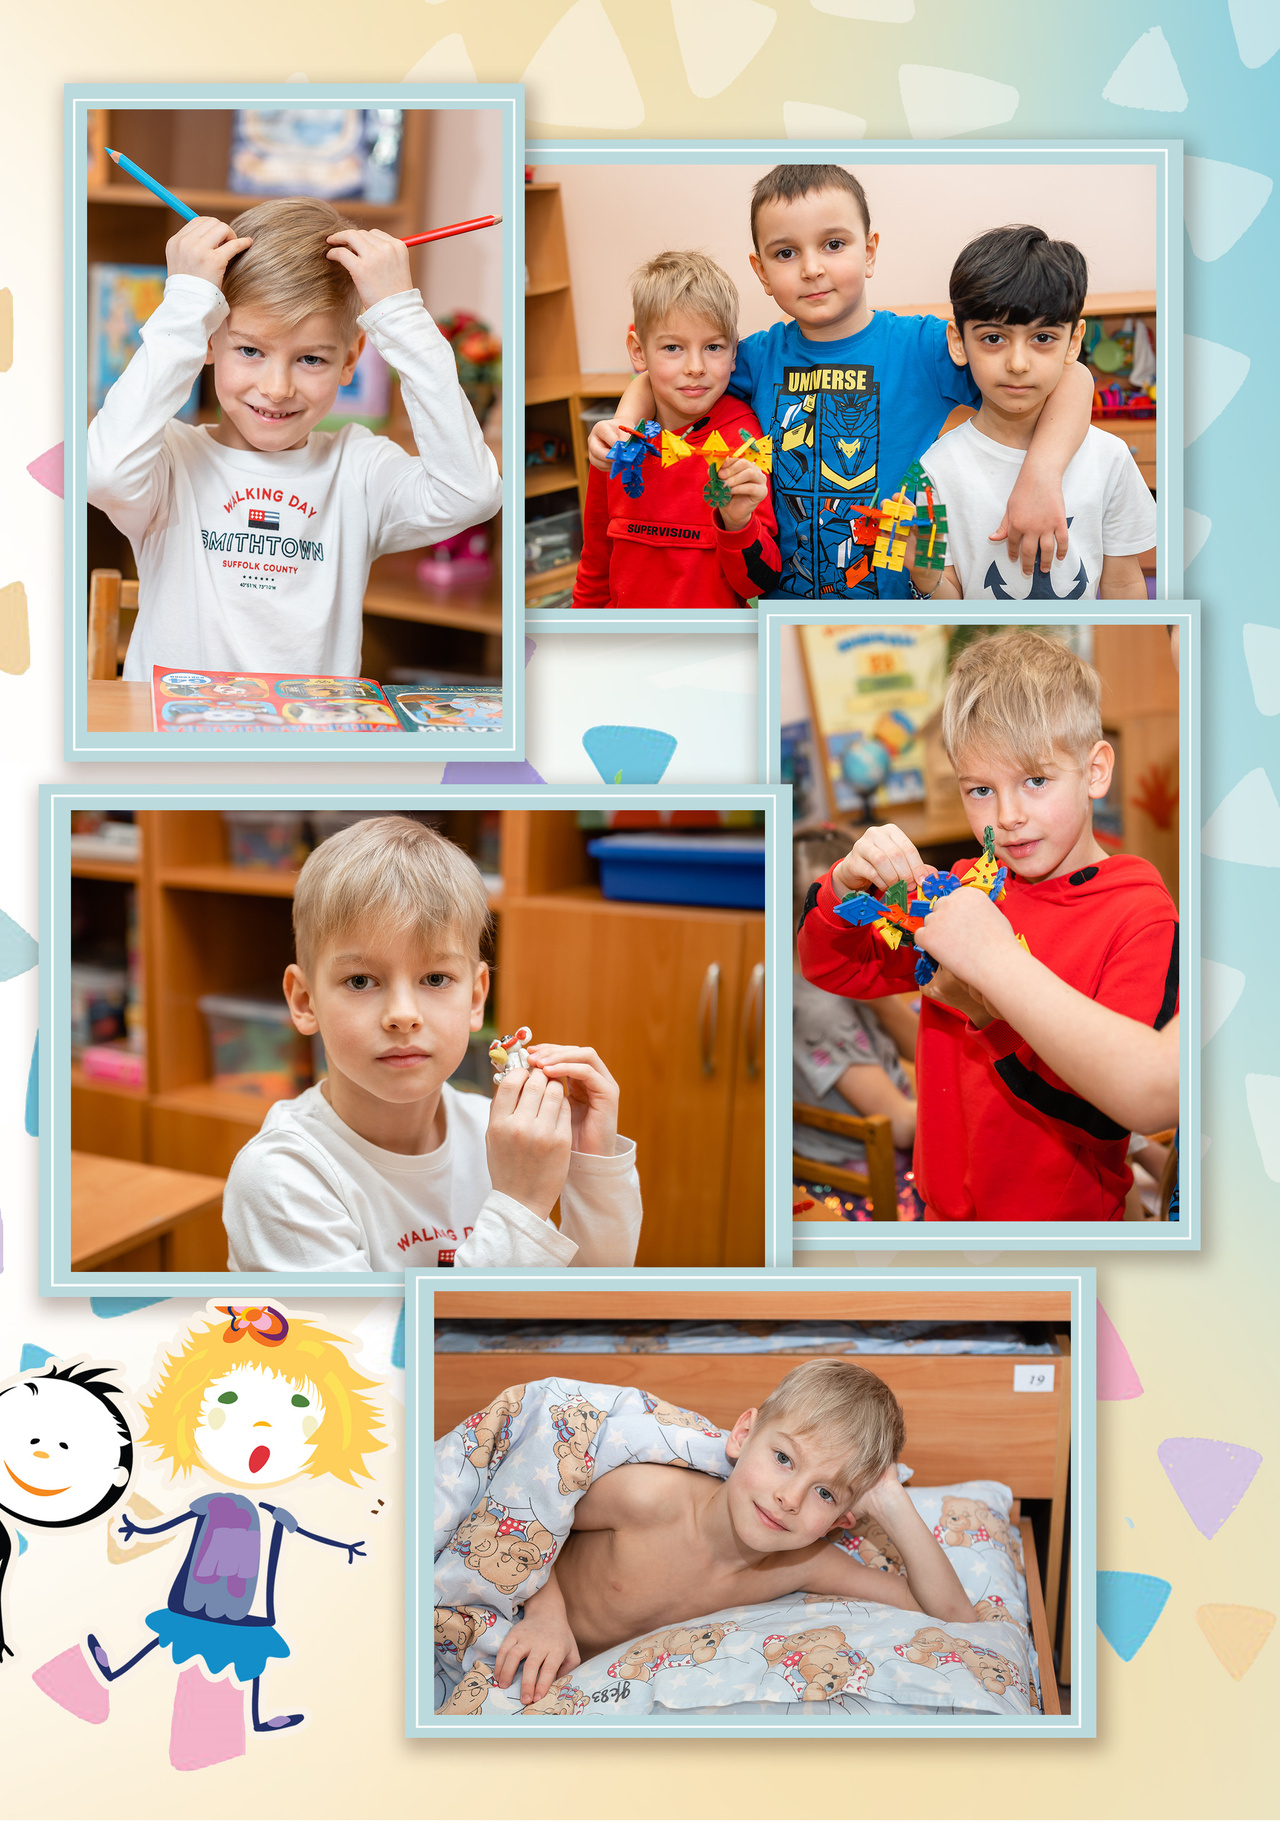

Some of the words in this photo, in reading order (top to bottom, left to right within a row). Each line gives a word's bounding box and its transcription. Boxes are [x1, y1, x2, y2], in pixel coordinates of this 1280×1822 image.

[788, 369, 867, 393] UNIVERSE
[223, 487, 284, 514] WALKING
[288, 494, 318, 519] DAY
[627, 523, 701, 541] SUPERVISION
[222, 559, 260, 571] SUFFOLK
[263, 563, 299, 575] COUNTY
[1029, 1374, 1046, 1387] 19
